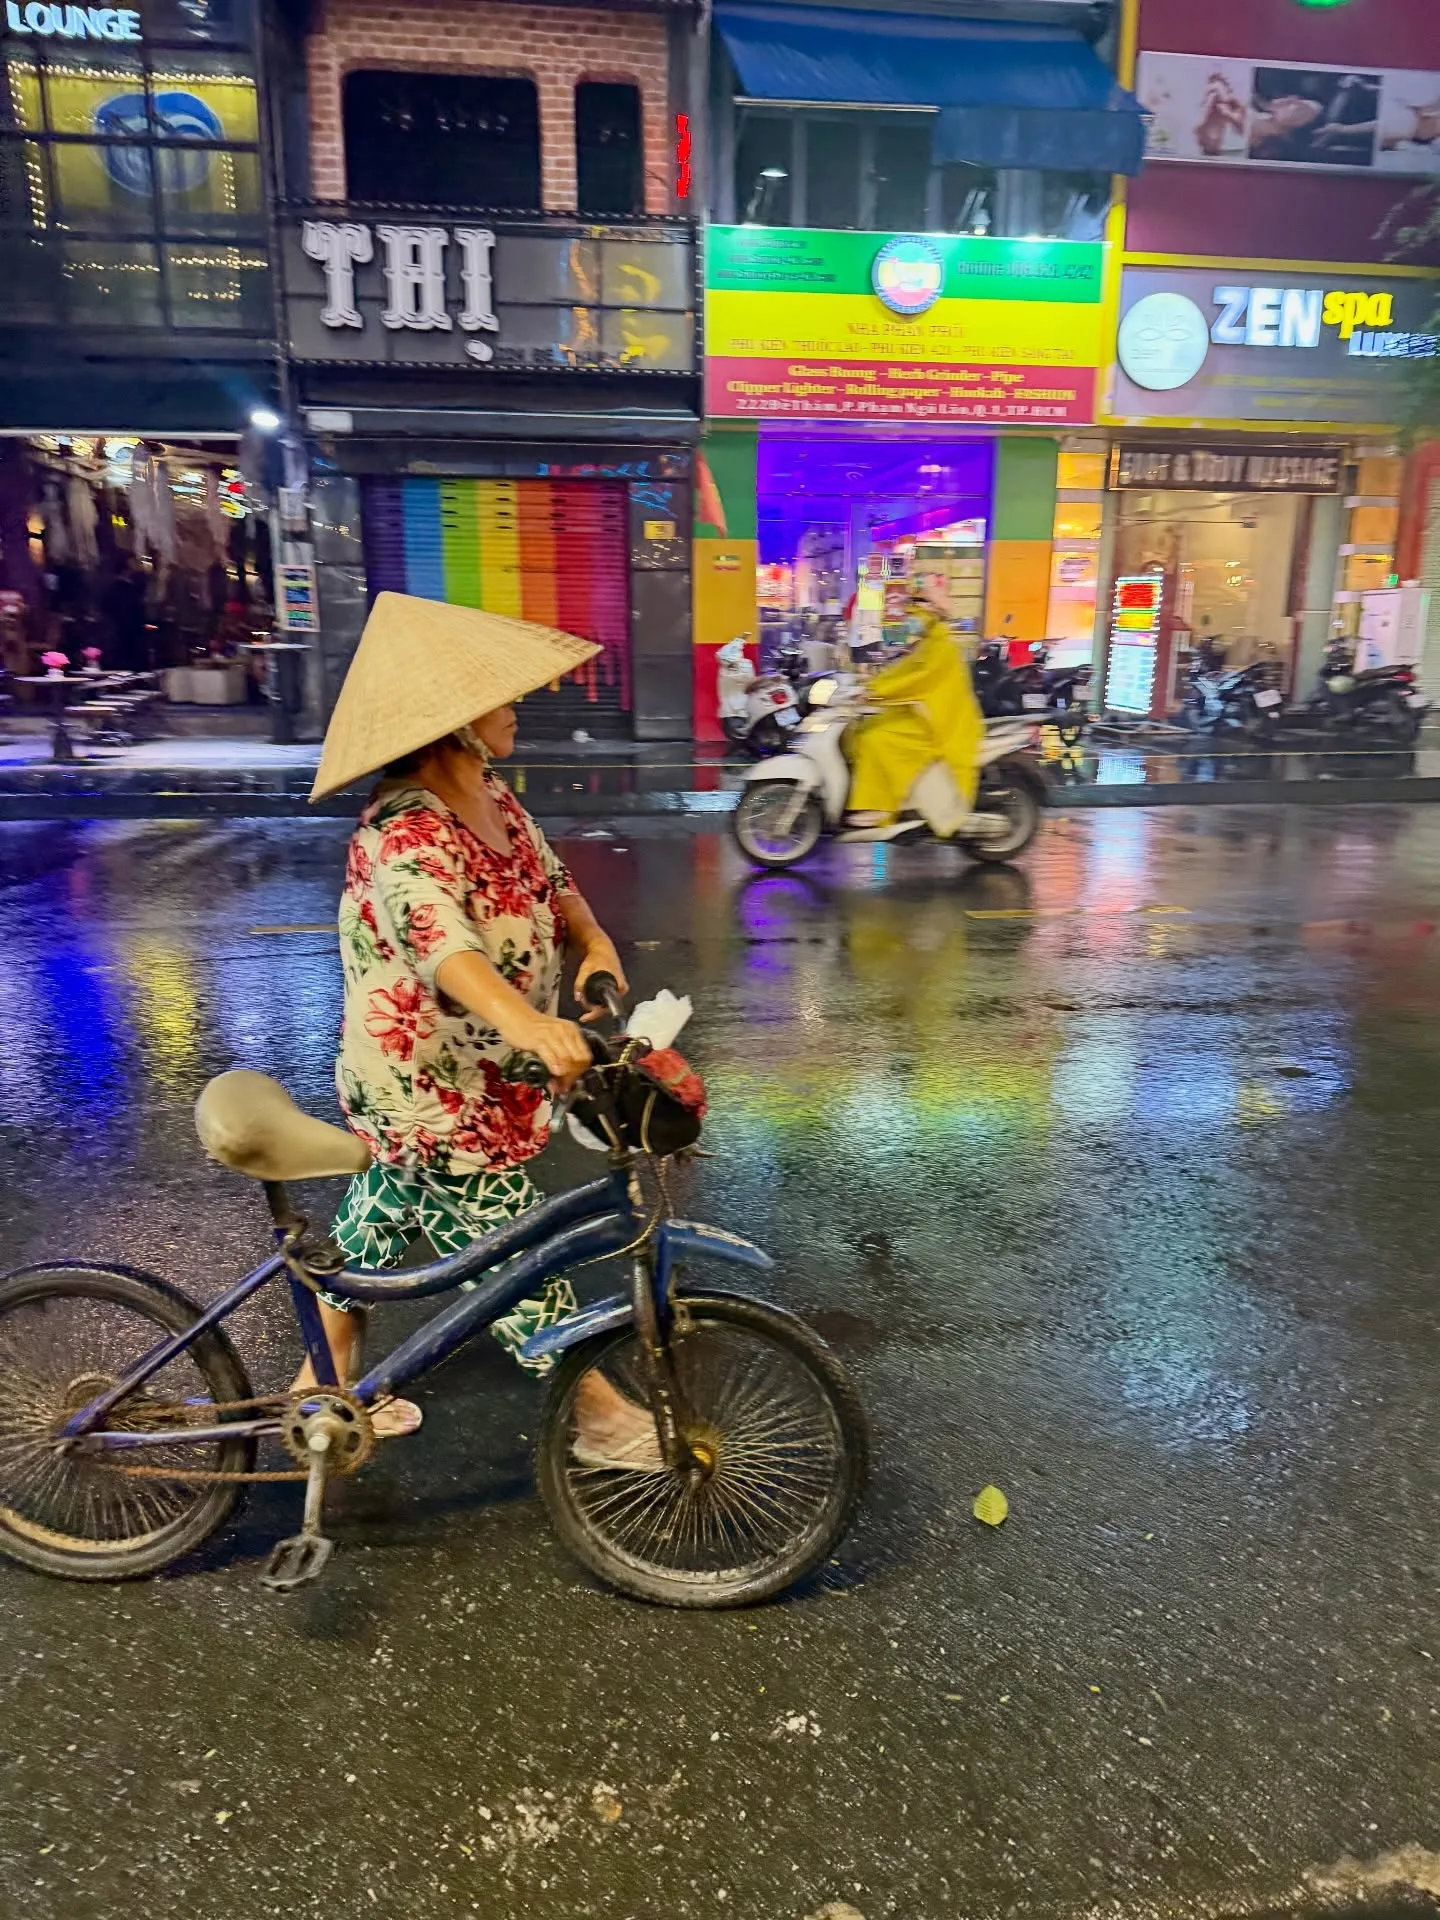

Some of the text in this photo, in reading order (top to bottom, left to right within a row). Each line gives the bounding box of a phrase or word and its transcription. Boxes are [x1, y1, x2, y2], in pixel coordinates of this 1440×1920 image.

[5, 0, 143, 40] LOUNGE
[1210, 286, 1395, 347] ZEN spa
[726, 380, 783, 396] Clipper
[783, 381, 837, 397] Lighter
[788, 365, 828, 377] Glass
[926, 369, 984, 383] Grinder
[990, 370, 1025, 385] Pipe
[1173, 453, 1190, 482] &
